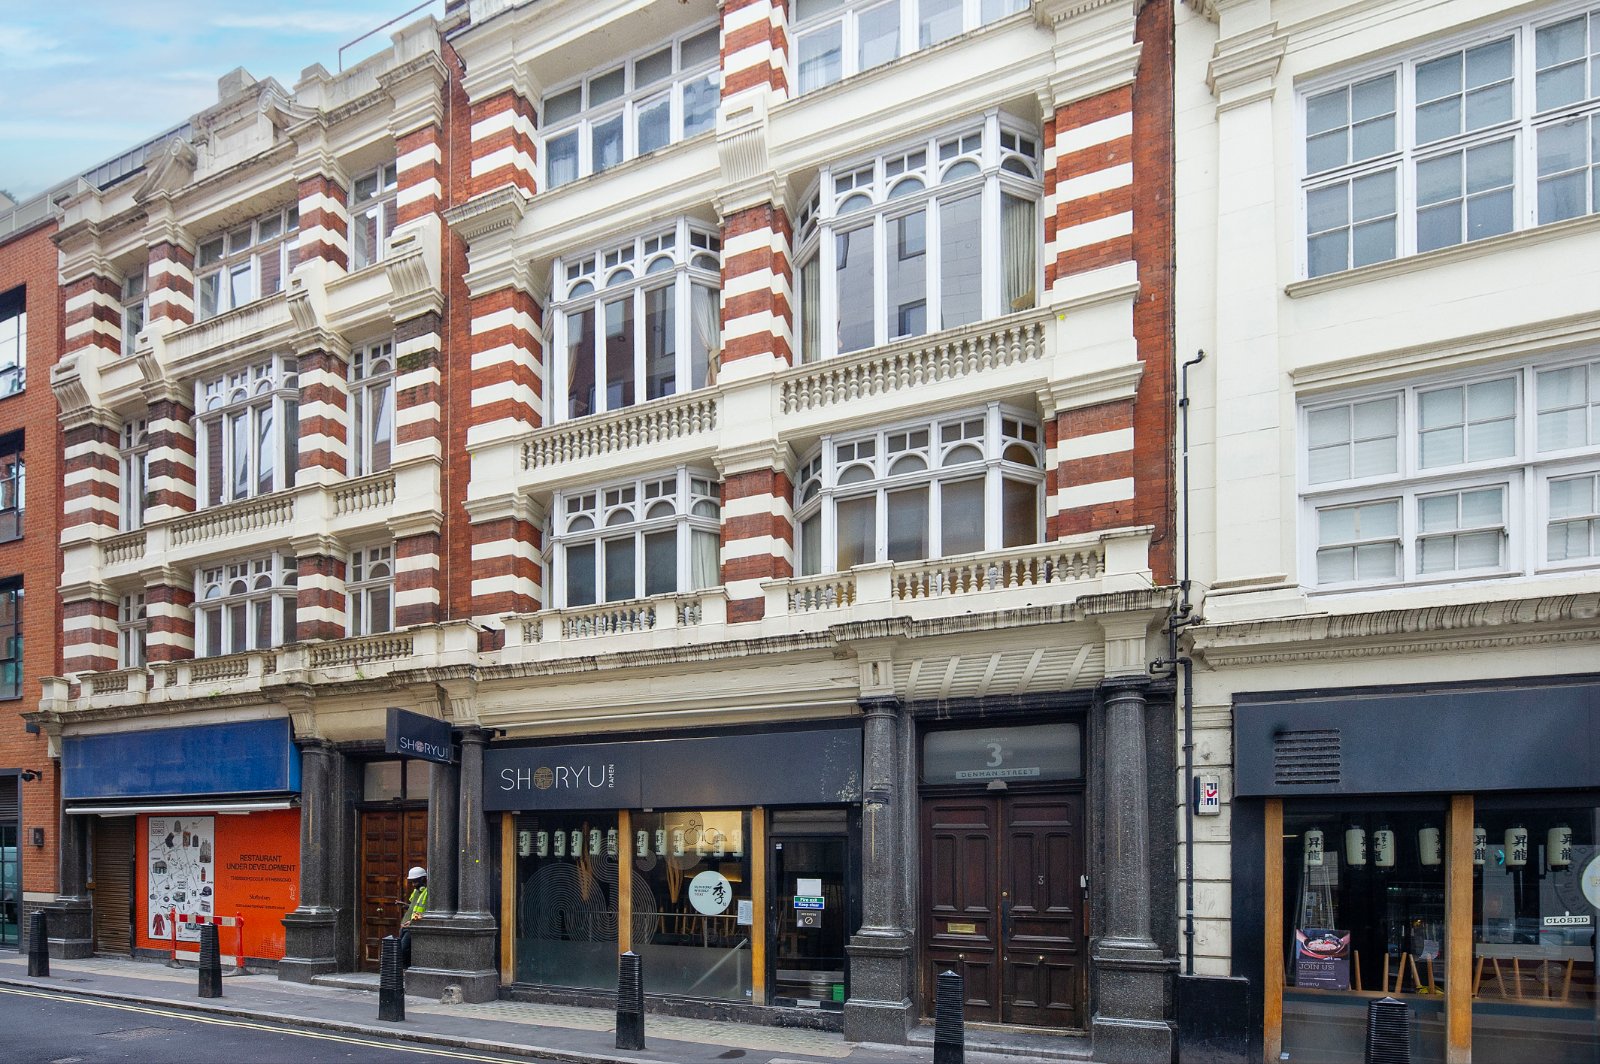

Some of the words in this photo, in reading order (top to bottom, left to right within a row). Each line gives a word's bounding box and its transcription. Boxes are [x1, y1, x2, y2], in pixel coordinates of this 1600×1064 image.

[400, 736, 445, 757] SHORYU
[986, 743, 1003, 767] 3
[1001, 768, 1034, 776] STREET
[500, 765, 605, 791] SHORYU
[239, 854, 282, 862] RESTAURANT
[248, 863, 296, 872] DEVELOPMENT
[1038, 875, 1044, 885] 3
